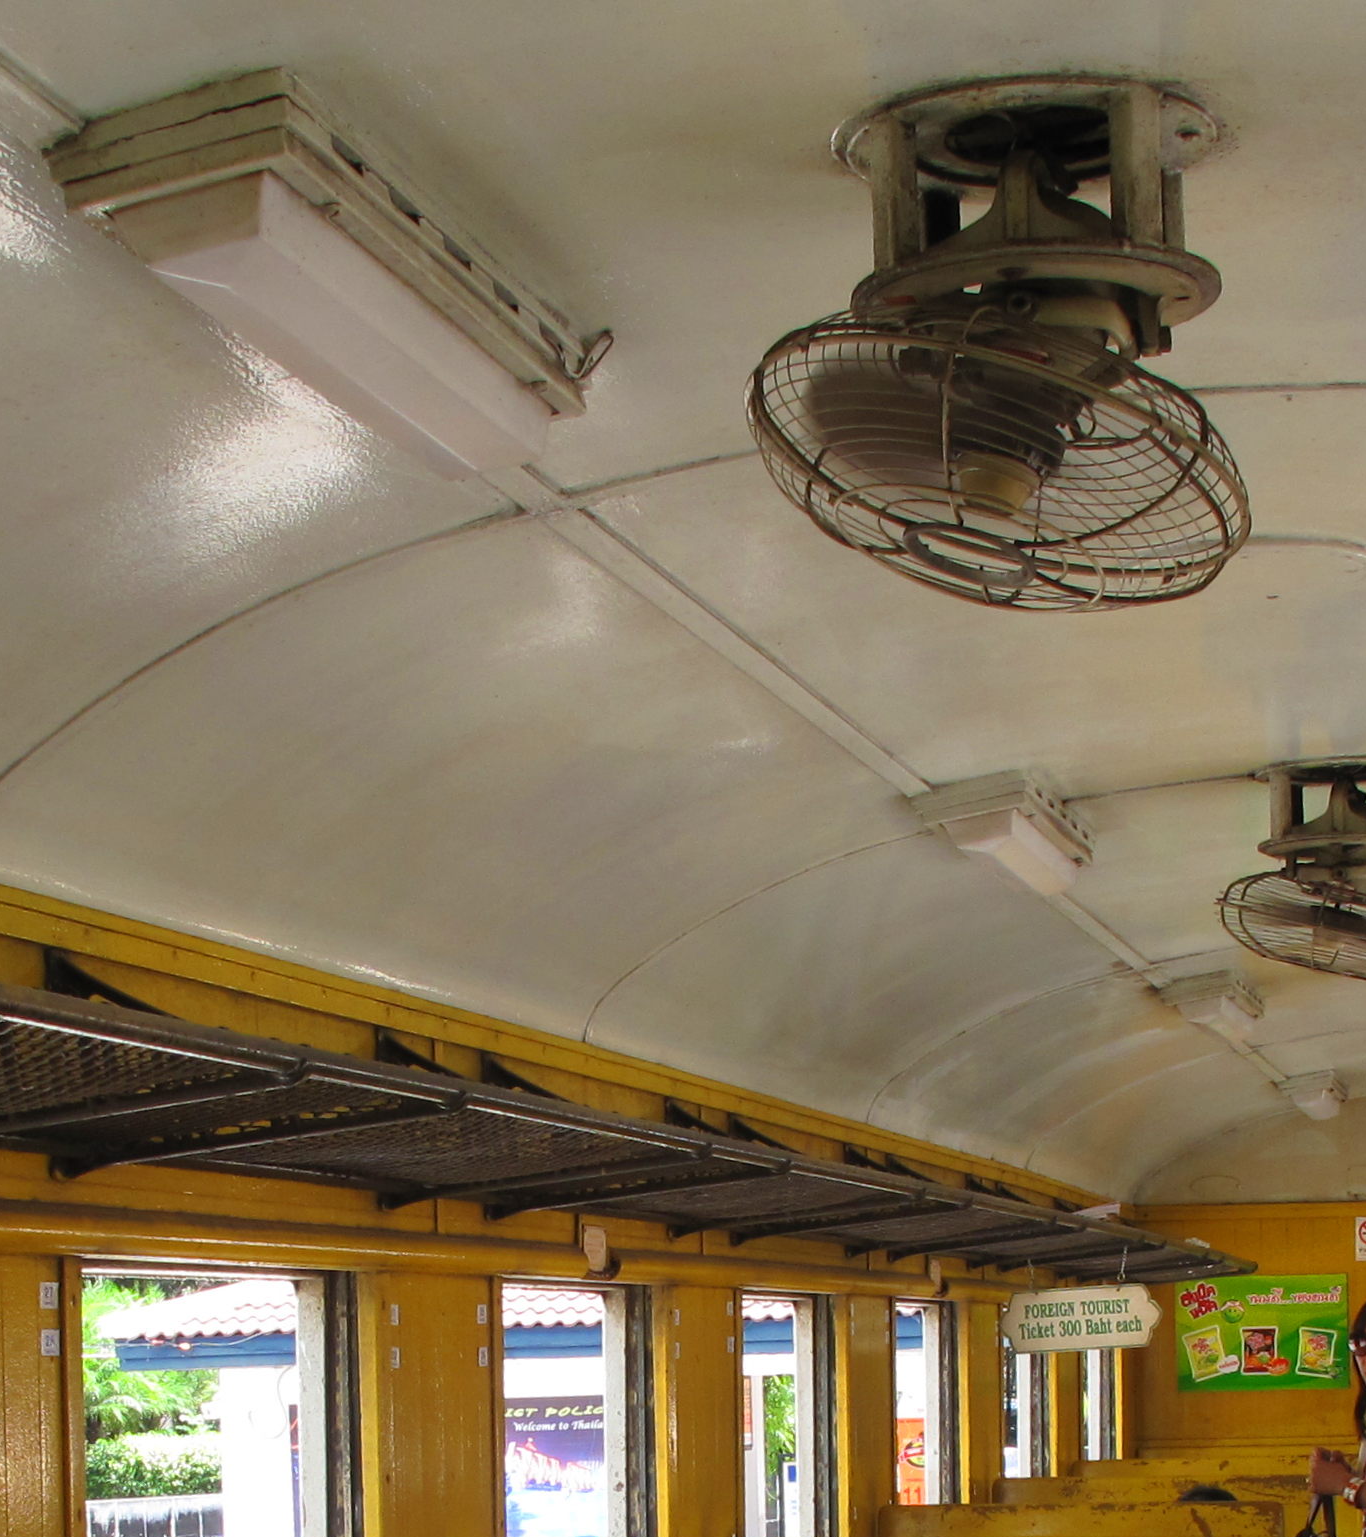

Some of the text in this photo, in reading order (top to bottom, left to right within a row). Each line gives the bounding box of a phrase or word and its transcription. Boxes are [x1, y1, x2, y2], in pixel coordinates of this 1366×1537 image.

[1024, 1299, 1130, 1319] FOREIGN TOURIST
[1018, 1316, 1143, 1340] Ticket 300 Baht each
[545, 1405, 604, 1418] POLIC
[513, 1418, 604, 1432] Welcome to Thaila
